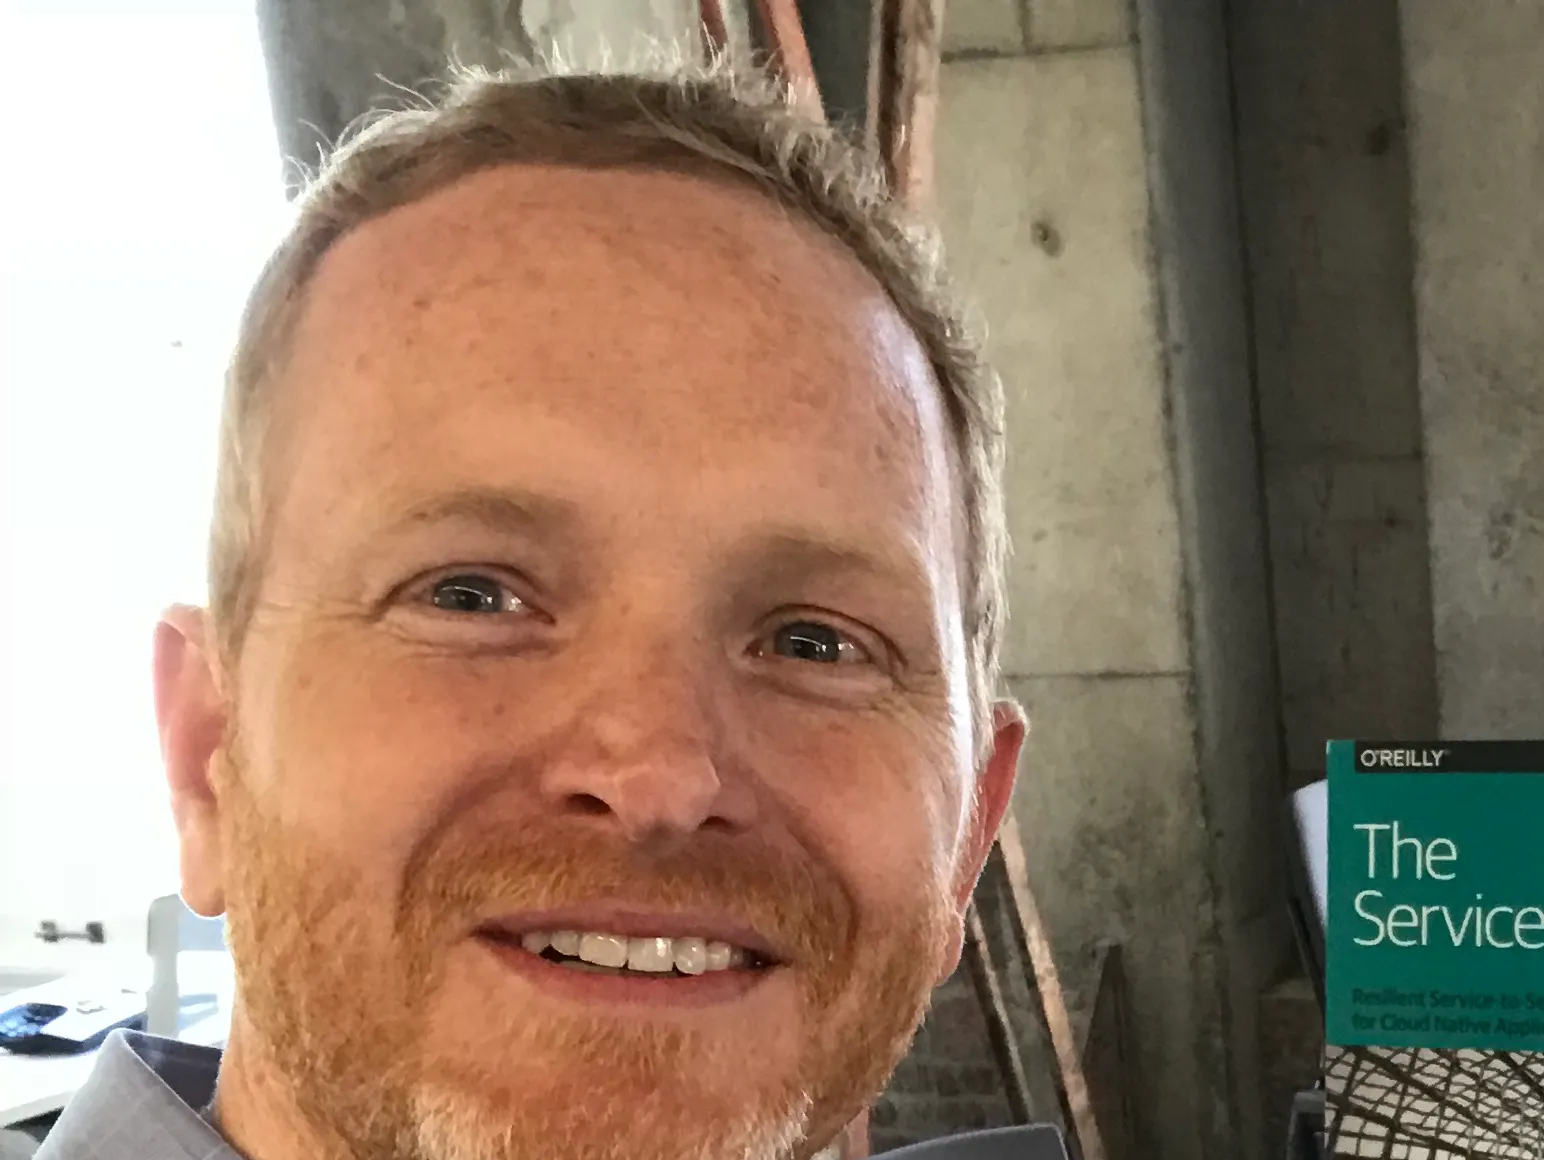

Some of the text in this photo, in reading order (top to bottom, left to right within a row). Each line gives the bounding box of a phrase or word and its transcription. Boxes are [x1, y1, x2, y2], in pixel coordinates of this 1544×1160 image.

[1353, 820, 1458, 881] The
[1352, 988, 1427, 1008] Resilient
[1352, 1014, 1376, 1031] for
[1380, 1013, 1431, 1032] Cloud
[1434, 1015, 1491, 1035] Native
